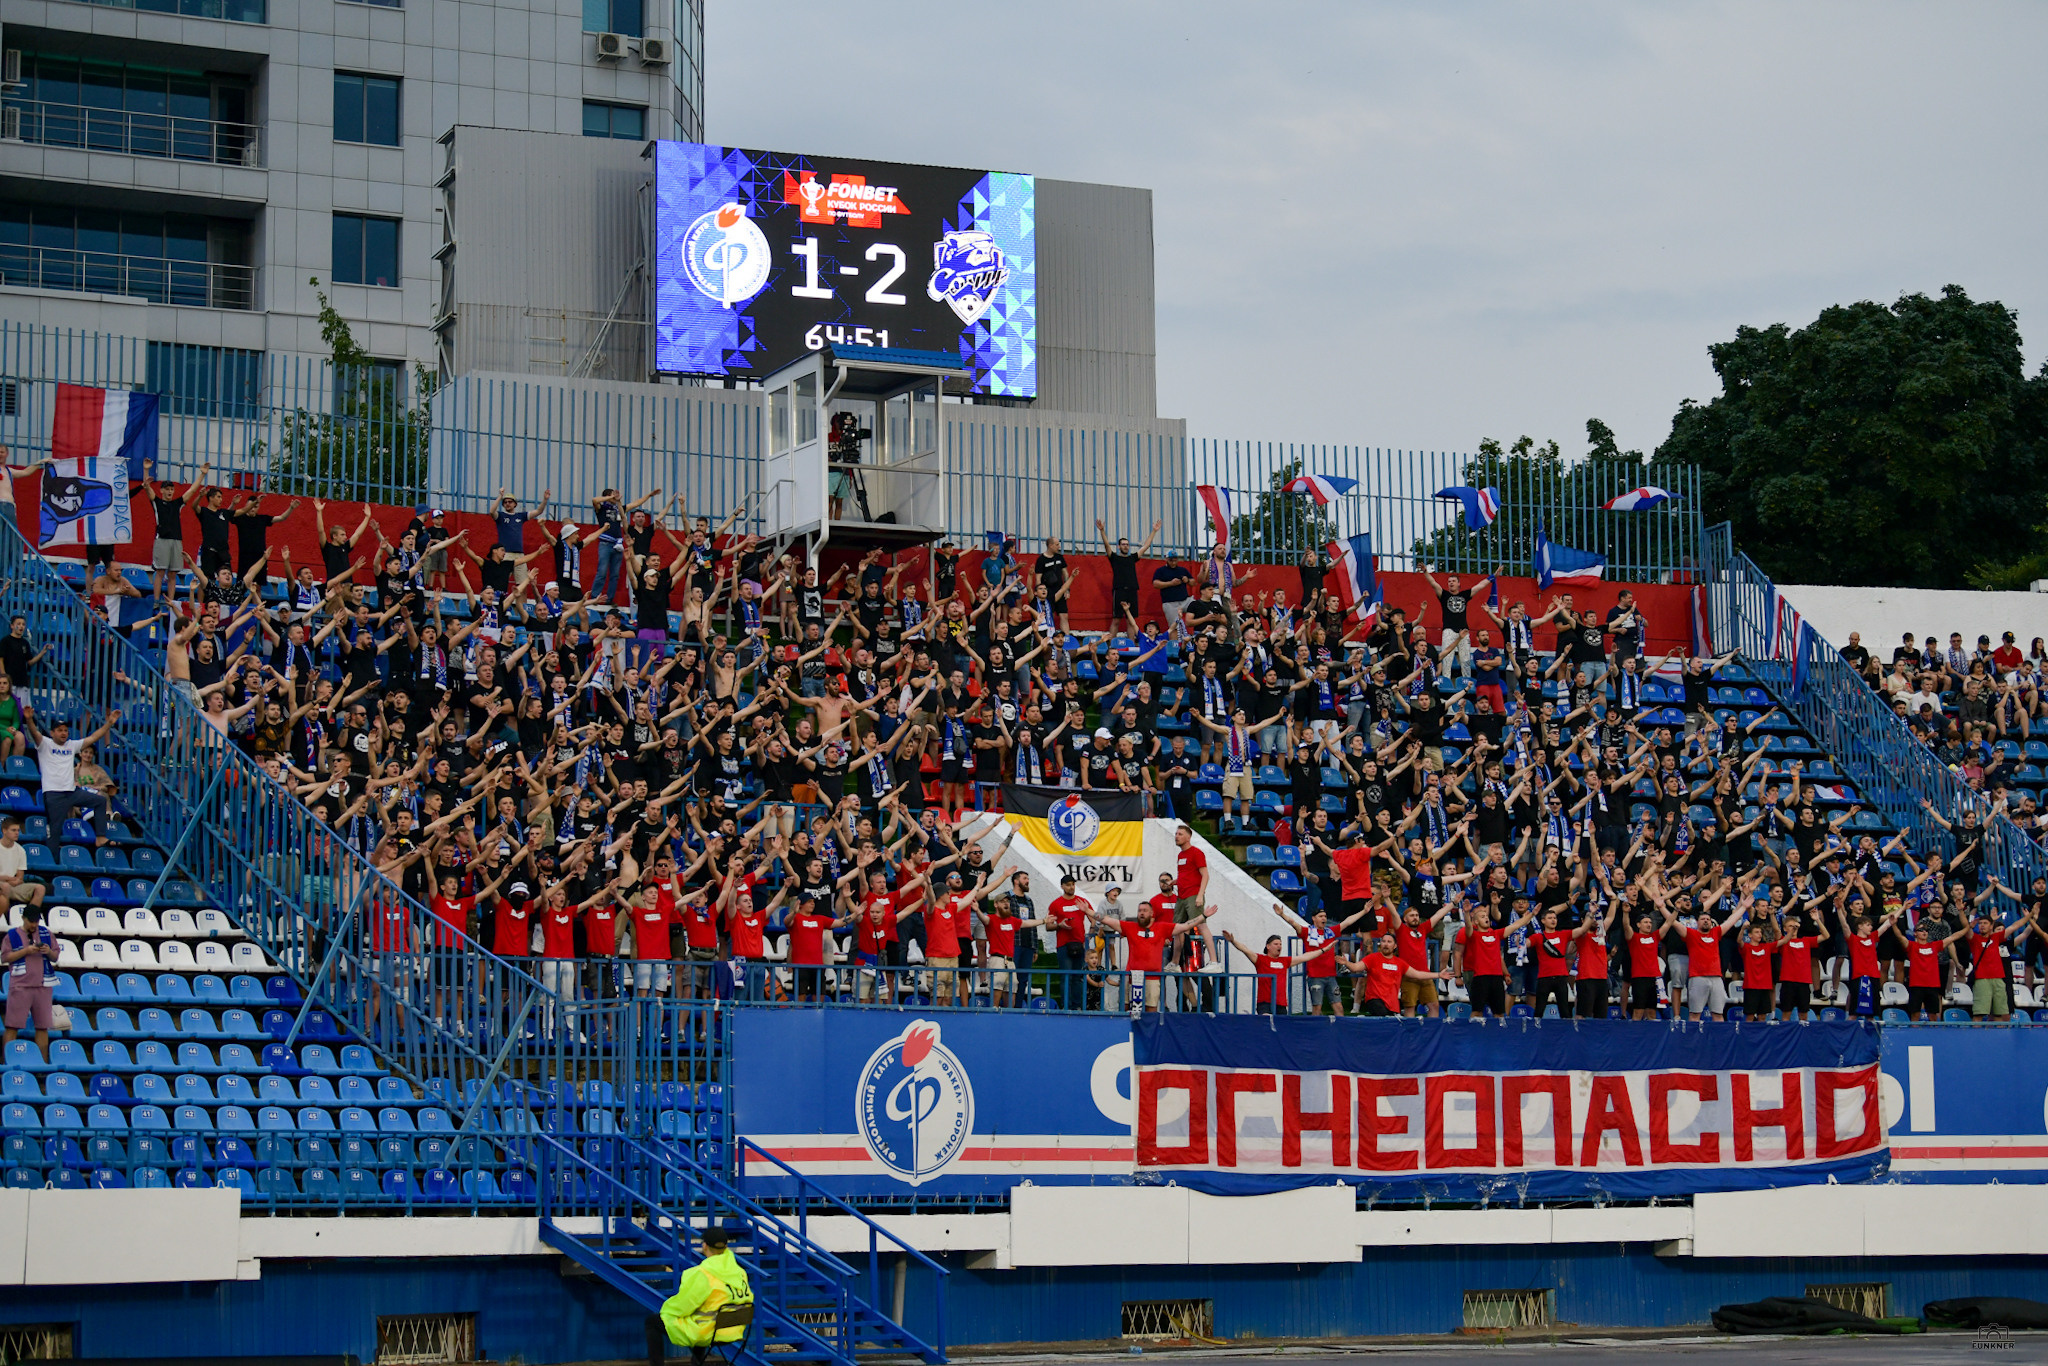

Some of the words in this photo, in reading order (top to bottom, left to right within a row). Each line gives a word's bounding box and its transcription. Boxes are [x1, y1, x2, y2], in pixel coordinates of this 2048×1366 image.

[827, 183, 898, 202] FONBET
[827, 200, 857, 210] КУБОК
[859, 202, 896, 214] РОССИИ
[805, 324, 889, 350] 64:51
[1056, 863, 1133, 882] НЕЖЪ
[873, 1054, 895, 1080] КЛУБ
[866, 1084, 897, 1162] ФУТБОЛЬНЫЙ
[1137, 1063, 1881, 1170] ОГНЕОПАСНО
[934, 1112, 964, 1162] ВОРОНЕЖ
